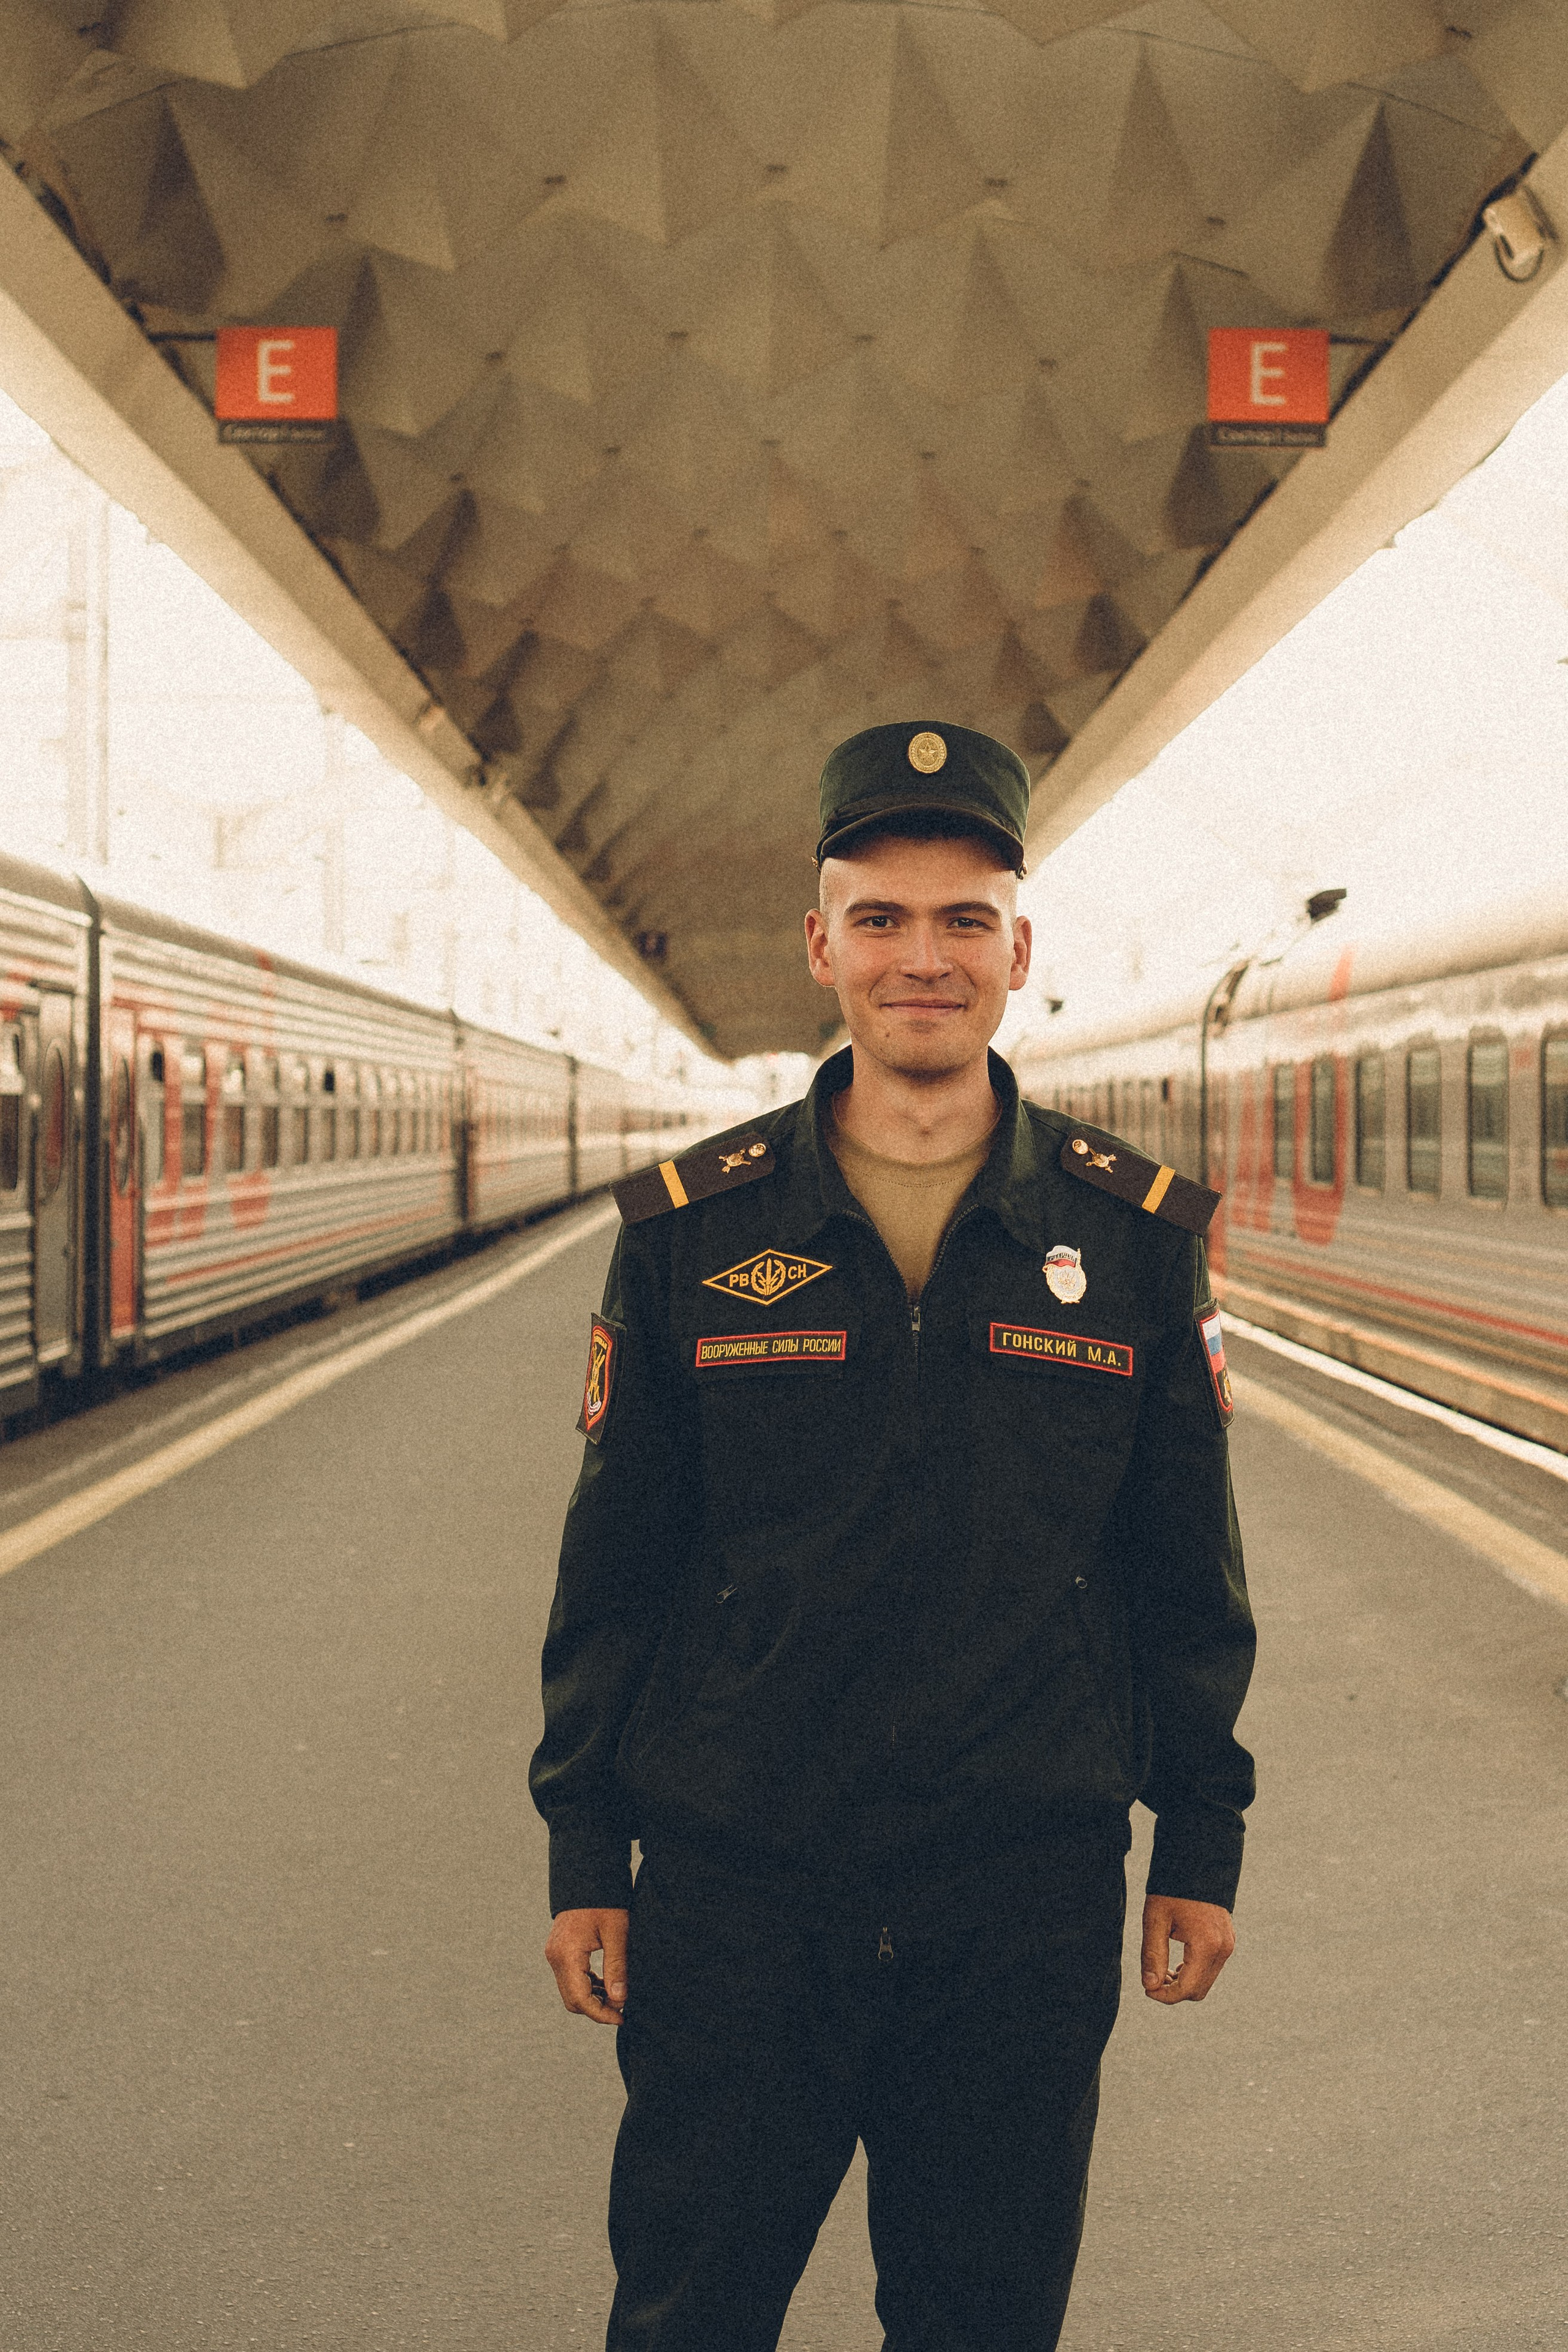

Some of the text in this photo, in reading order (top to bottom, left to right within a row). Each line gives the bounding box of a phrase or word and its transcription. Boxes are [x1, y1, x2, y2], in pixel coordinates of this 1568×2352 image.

[258, 339, 295, 404] E
[1251, 341, 1287, 405] E
[701, 1338, 842, 1359] ВООРУЖЕННЫЕ СИЛЫ РОССИИ
[1003, 1332, 1121, 1366] ГОНСКИЙ М.А.
